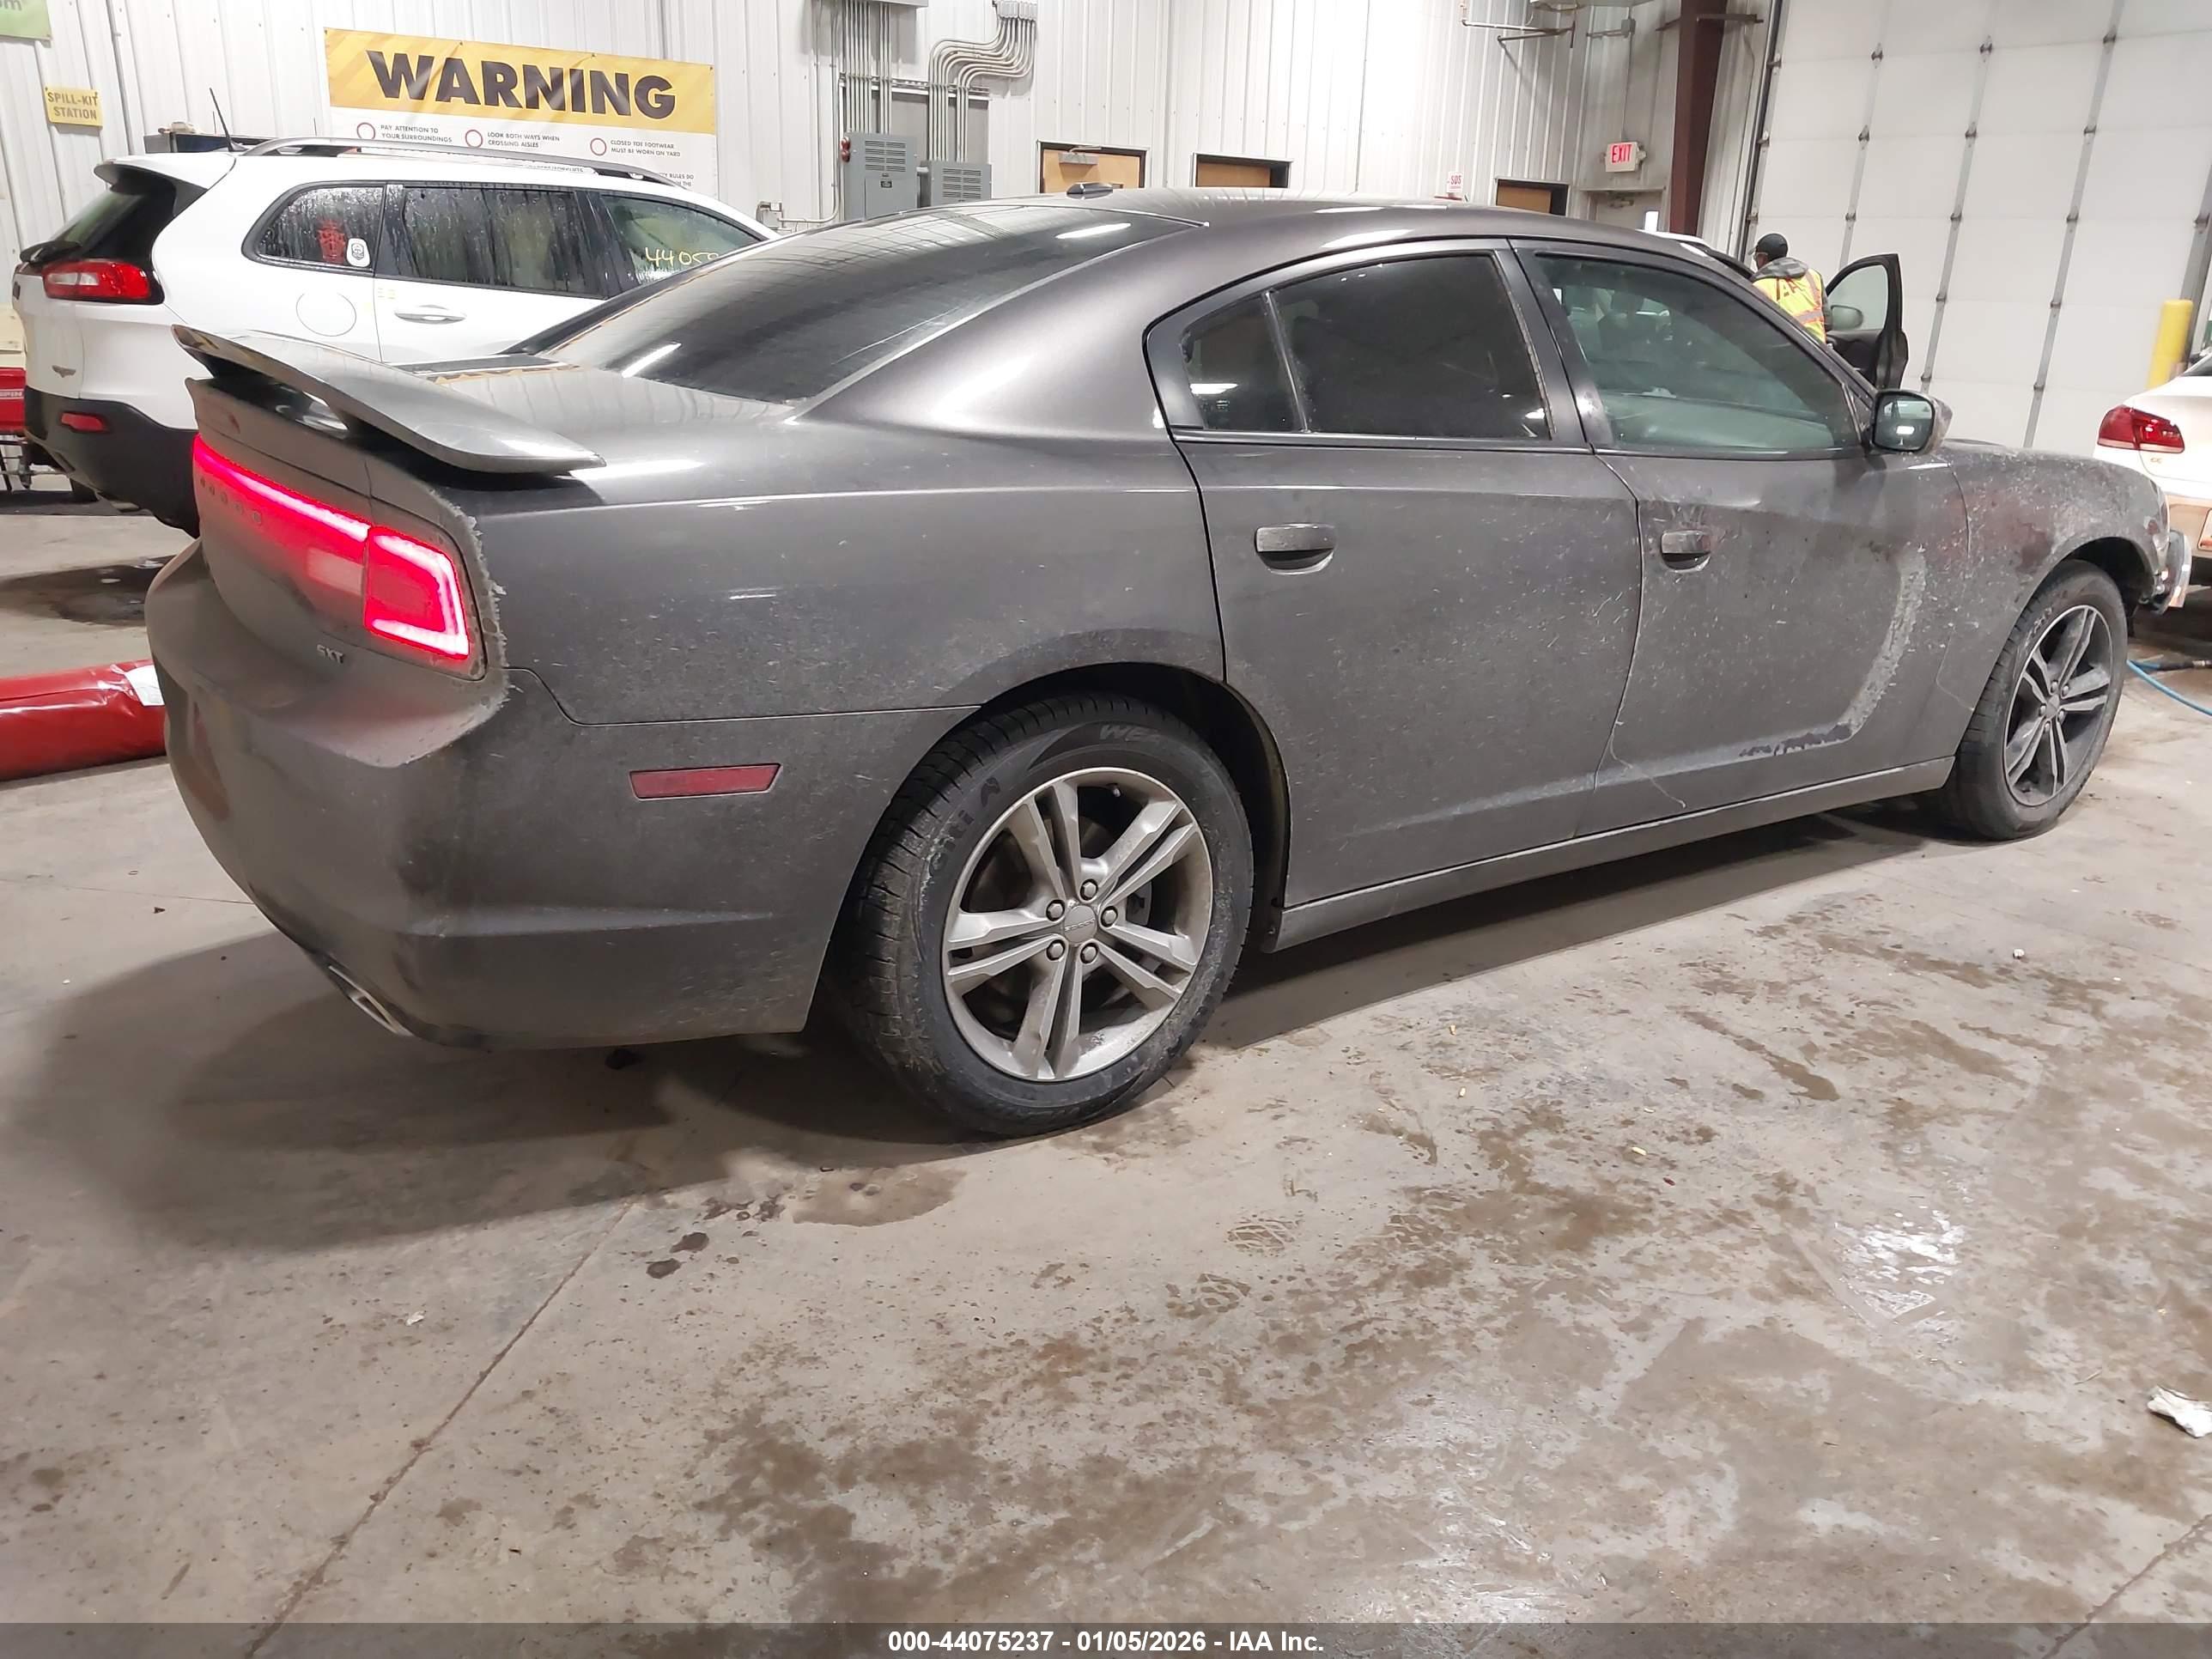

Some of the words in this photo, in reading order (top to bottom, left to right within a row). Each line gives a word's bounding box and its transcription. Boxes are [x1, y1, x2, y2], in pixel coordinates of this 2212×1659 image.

[367, 50, 676, 118] WARNING
[47, 92, 98, 106] SPILL-KIT
[53, 106, 97, 119] STATION
[401, 134, 453, 143] SURROUNDINGS
[1612, 143, 1632, 163] EXIT
[1450, 175, 1462, 185] SOS
